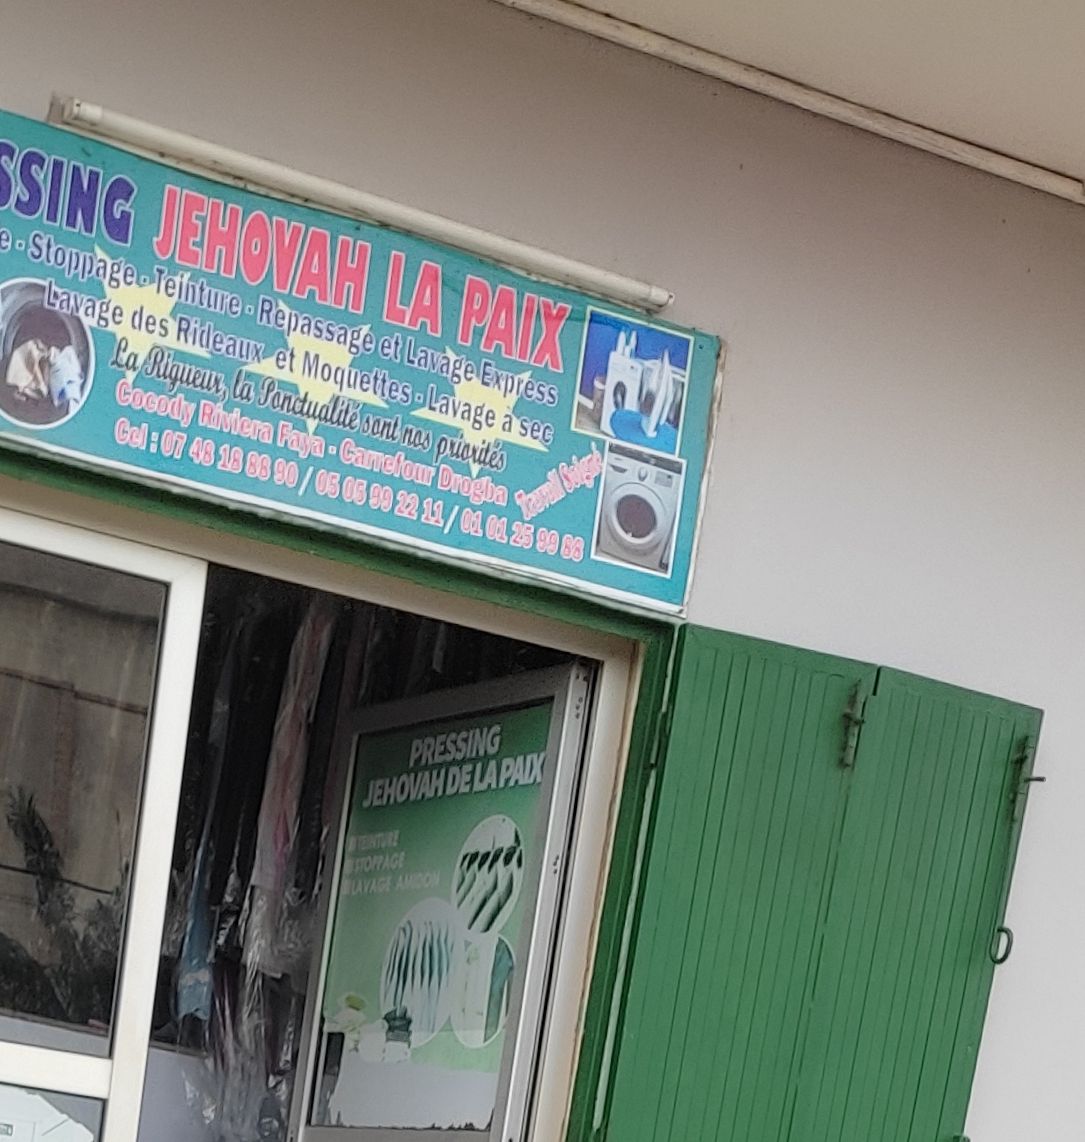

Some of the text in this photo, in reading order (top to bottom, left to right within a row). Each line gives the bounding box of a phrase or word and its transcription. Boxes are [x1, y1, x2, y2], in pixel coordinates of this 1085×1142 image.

[29, 232, 138, 287] Stoppage
[154, 266, 242, 316] Teinture
[258, 296, 375, 355] Repassage
[380, 332, 403, 362] et
[405, 337, 476, 385] Lavage
[480, 359, 559, 407] Express
[154, 185, 371, 314] JEHOVAH
[383, 251, 442, 337] LA
[458, 275, 571, 372] PAIX
[45, 280, 124, 328] Lavage
[130, 305, 170, 338] des
[176, 315, 265, 363] Rideaux
[275, 347, 296, 374] et
[302, 350, 412, 404] Moquettes
[427, 384, 497, 431] Lavage
[519, 416, 554, 444] sec
[110, 336, 140, 371] La
[233, 366, 255, 402] la
[259, 377, 359, 430] Ponctualité
[361, 414, 402, 442] sont
[401, 425, 432, 450] nos
[434, 431, 506, 471] priorités
[115, 379, 196, 427] Cocody
[199, 400, 274, 445] Riviera
[277, 420, 326, 458] Faya
[340, 438, 436, 486] Carrefour
[438, 465, 508, 506] Drogba
[115, 418, 148, 449] Cel
[161, 429, 187, 459] 07
[189, 437, 215, 466] 48
[273, 458, 299, 487] 90
[316, 469, 340, 497] 05
[342, 476, 367, 504] 05
[394, 490, 419, 520] 22
[421, 498, 444, 527] 11
[460, 507, 483, 537] 01
[486, 514, 508, 543] 01
[509, 521, 534, 549] 25
[362, 751, 548, 808] JEHOVAH DE LA PAIX
[409, 724, 502, 768] PRESSING
